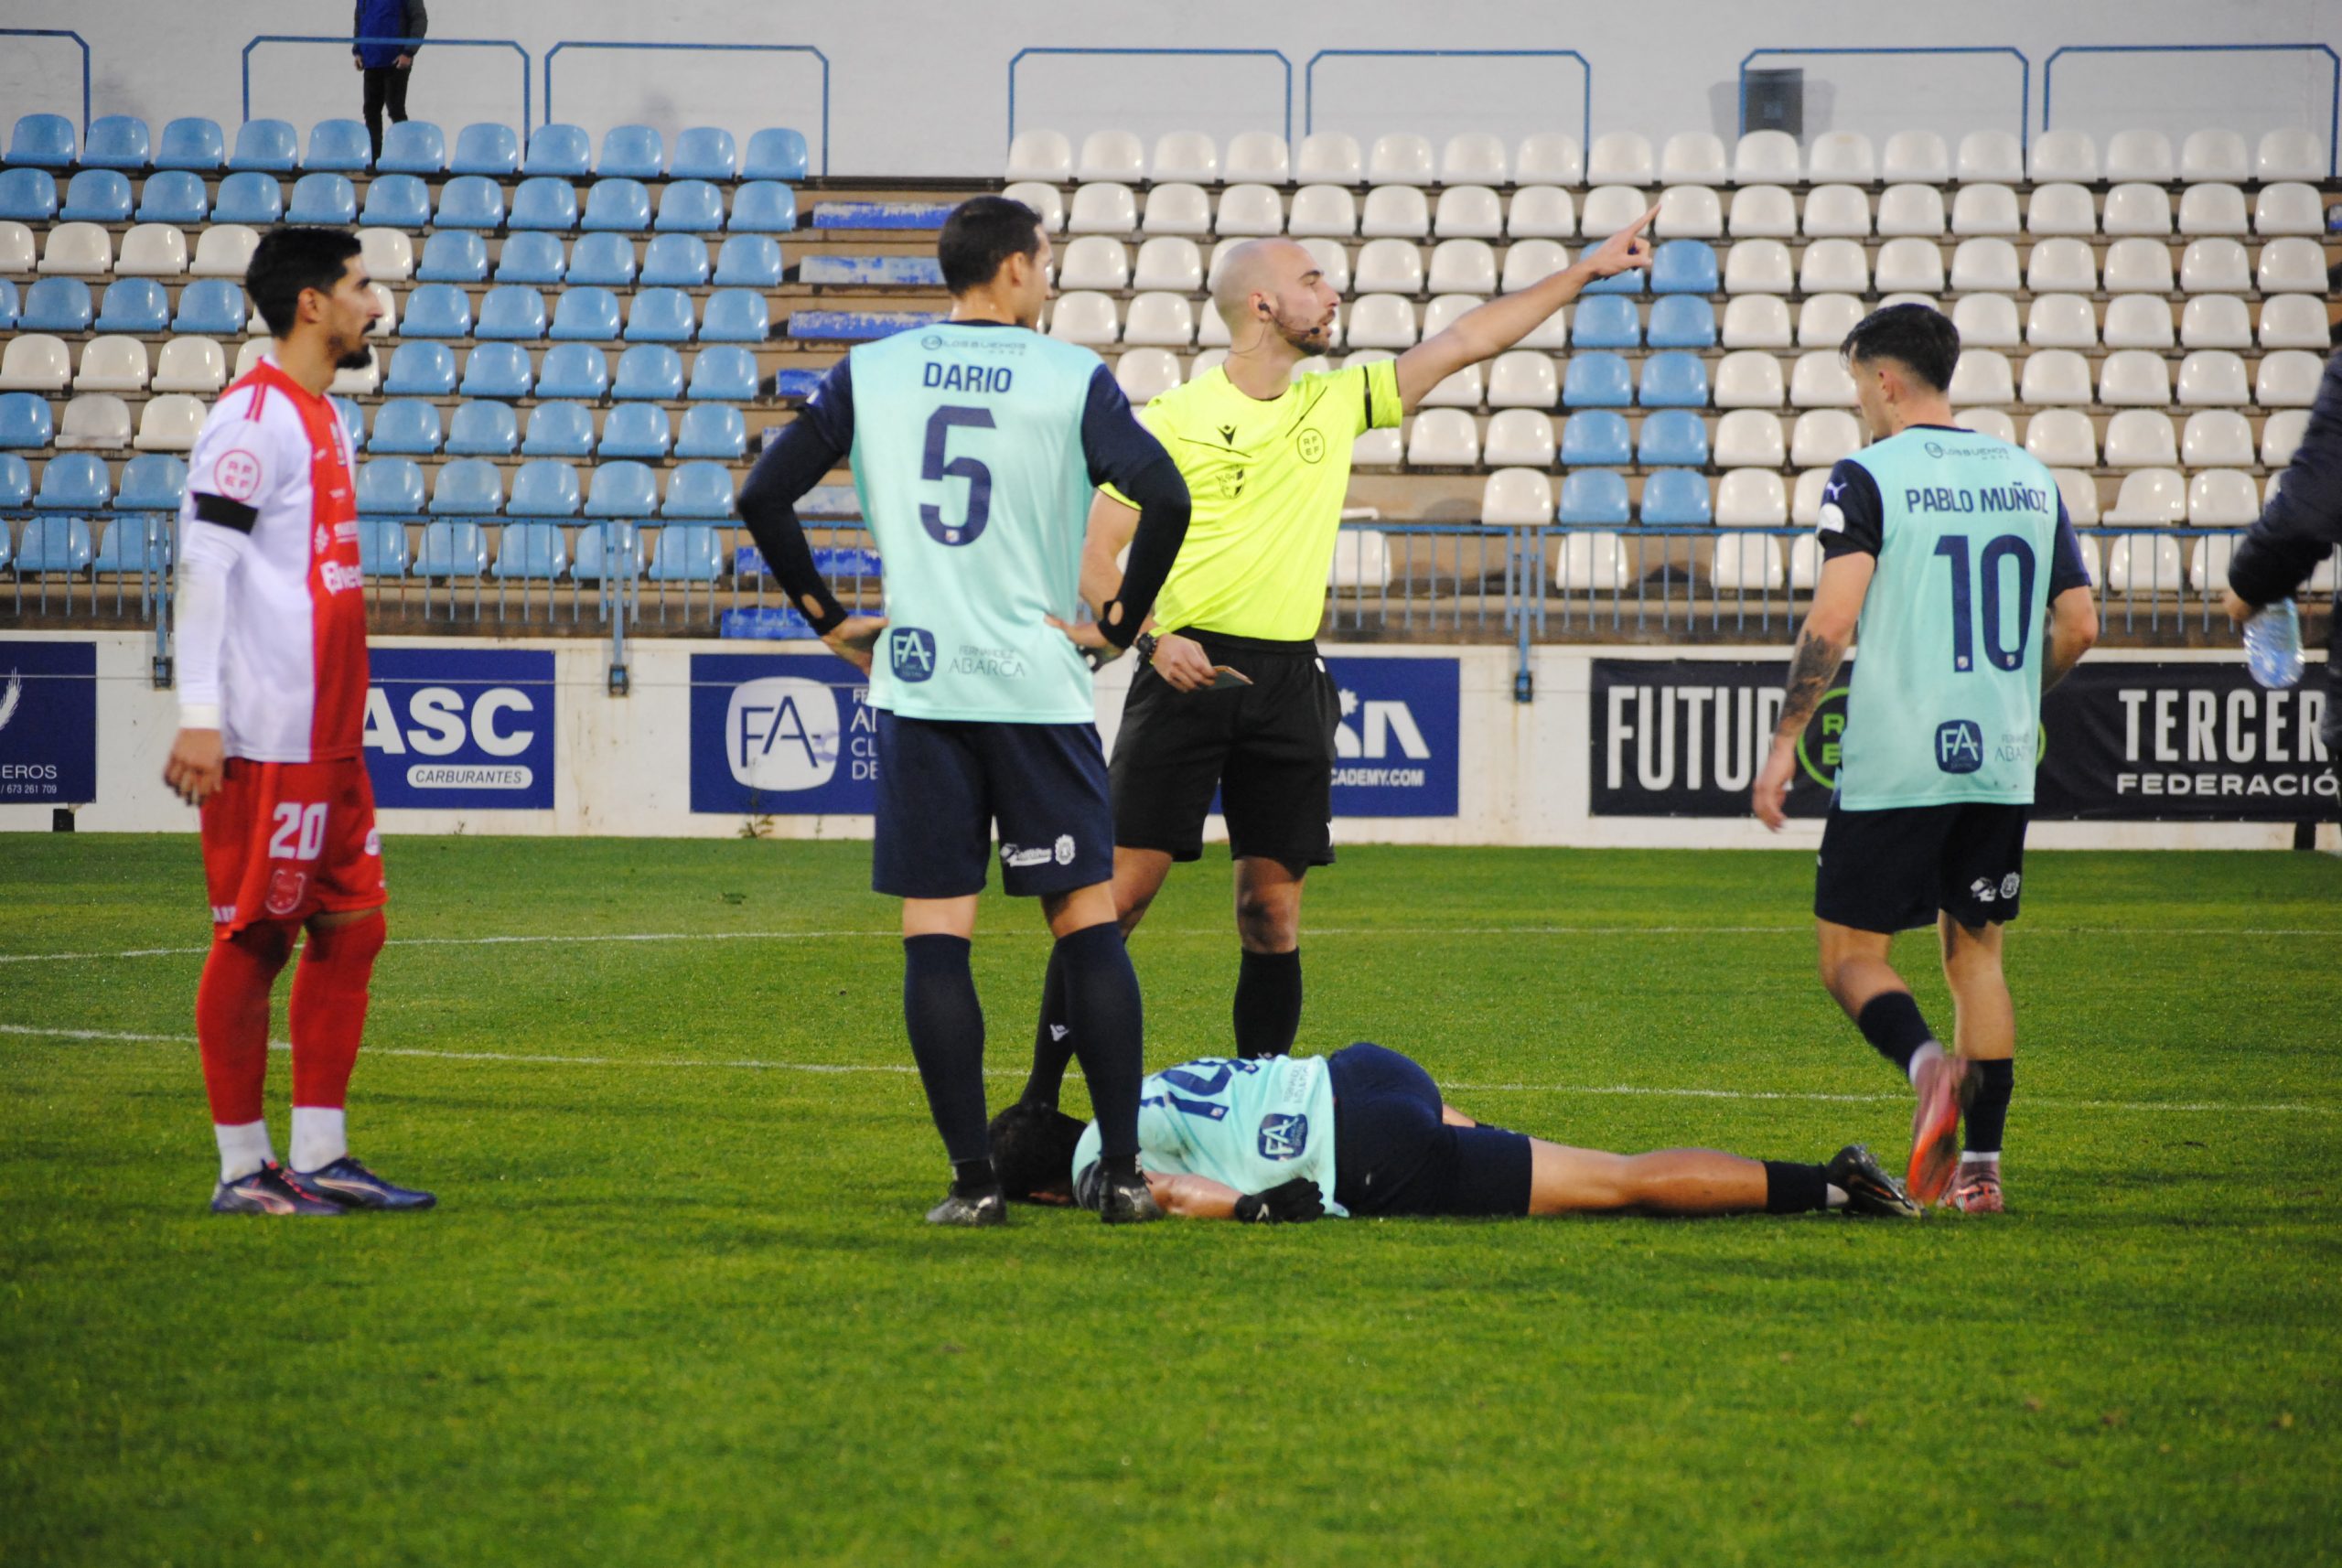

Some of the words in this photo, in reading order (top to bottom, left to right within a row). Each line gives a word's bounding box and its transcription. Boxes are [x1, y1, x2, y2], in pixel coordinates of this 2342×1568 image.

[922, 362, 1013, 392] DARIO
[919, 405, 996, 546] 5
[1906, 489, 1973, 513] PABLO
[1981, 481, 2048, 514] MUÑOZ
[1934, 534, 2036, 673] 10
[893, 631, 930, 671] FA
[948, 658, 1026, 677] ABARCA
[362, 687, 534, 757] ASC
[741, 695, 821, 768] FA
[2119, 689, 2328, 762] TERCER
[1941, 723, 1979, 762] FA
[2, 764, 57, 779] EROS
[6, 784, 22, 794] 673
[25, 784, 38, 794] 261
[42, 784, 57, 794] 709
[415, 769, 522, 784] CARBURANTES
[2117, 768, 2338, 796] FEDERACIÓ
[269, 802, 328, 860] 20
[1262, 1116, 1299, 1155] FA
